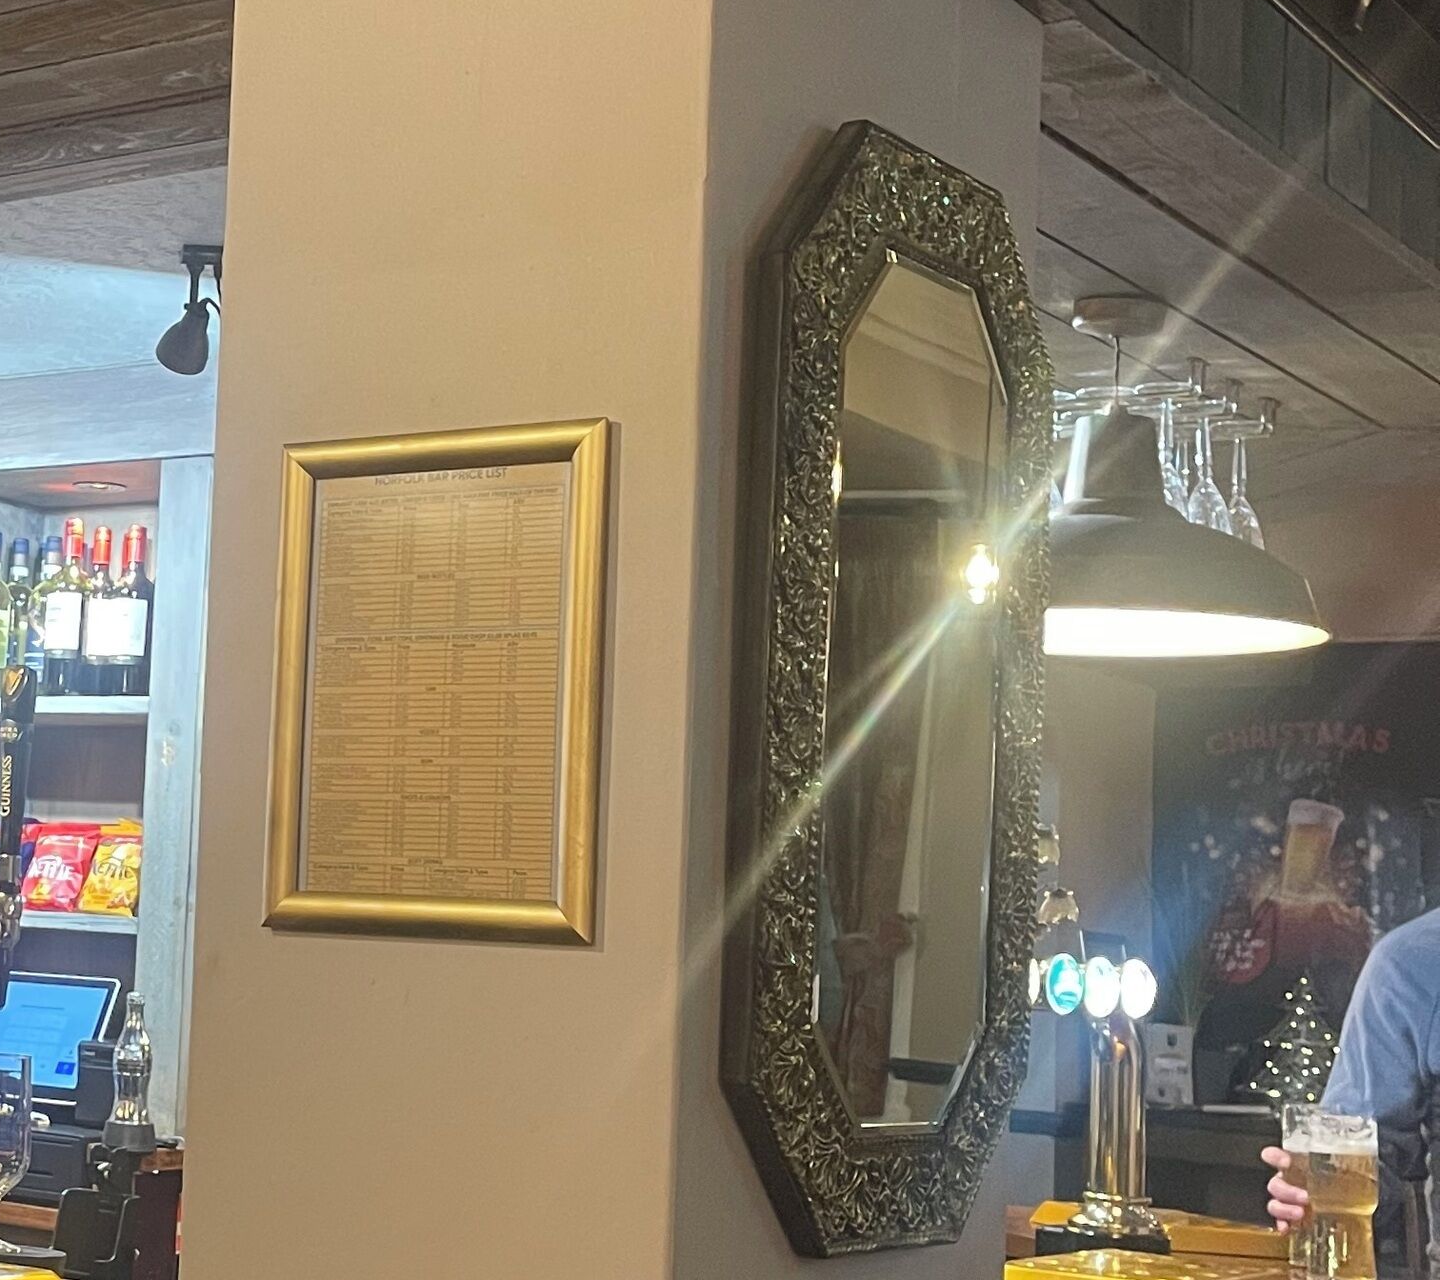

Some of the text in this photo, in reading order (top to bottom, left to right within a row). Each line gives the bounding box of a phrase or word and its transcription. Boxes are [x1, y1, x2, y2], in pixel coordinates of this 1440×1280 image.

[375, 466, 507, 487] NORFOLK BAR PRICE LIST
[1206, 721, 1391, 754] CHRISTMAS
[0, 754, 12, 817] GUINNESS
